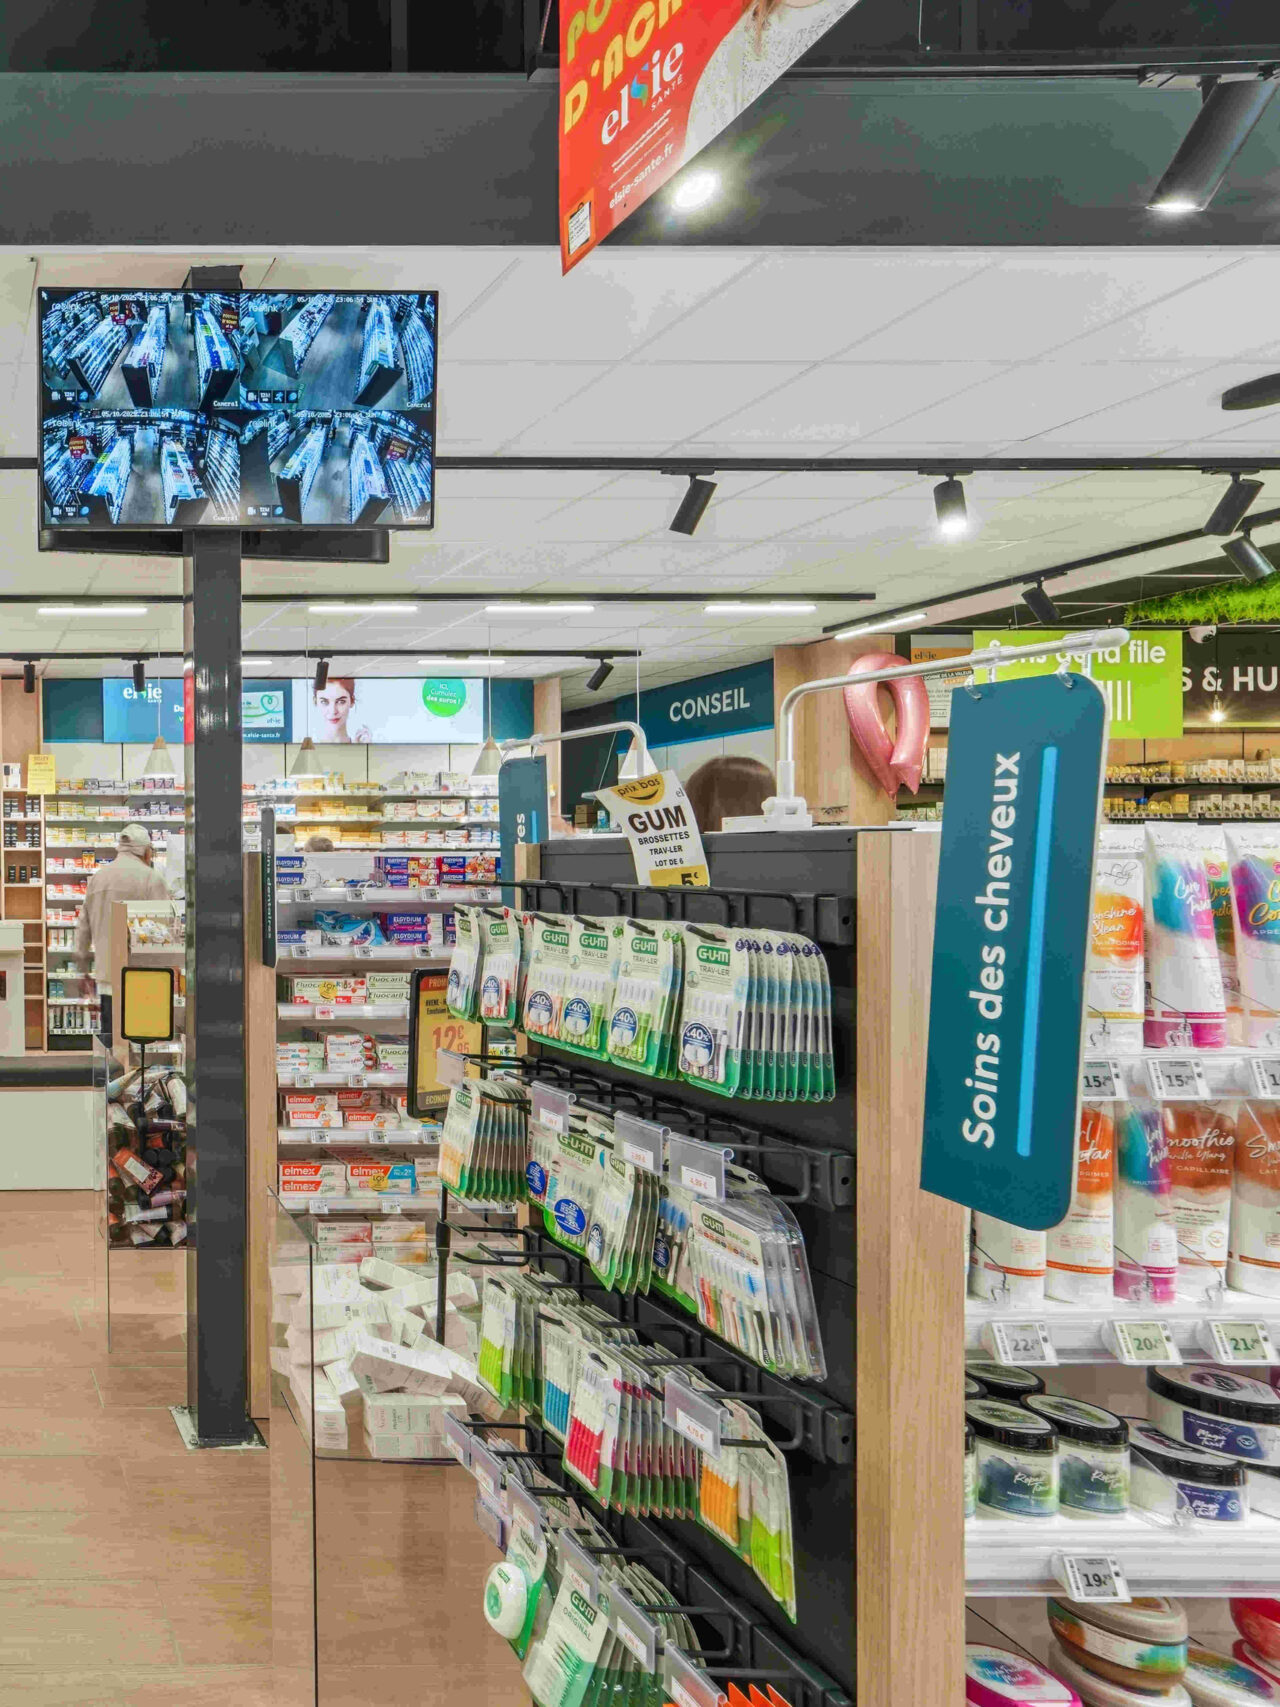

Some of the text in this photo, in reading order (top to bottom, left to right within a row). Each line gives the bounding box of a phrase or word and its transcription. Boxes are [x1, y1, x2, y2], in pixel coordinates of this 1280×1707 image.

[609, 143, 673, 209] elsie-sante.fr
[1128, 640, 1166, 664] file
[430, 689, 457, 698] Cumulez
[440, 696, 456, 704] euros
[669, 687, 750, 723] CONSEIL
[628, 804, 687, 834] GUM
[638, 831, 690, 846] BROSSETTES
[649, 845, 683, 857] TRAV-LER
[654, 858, 668, 867] LOT
[669, 858, 679, 867] DE
[962, 751, 1021, 1149] Soins des cheveux
[368, 991, 404, 999] Fluocaril
[284, 1167, 315, 1176] elmex
[352, 1167, 384, 1176] elmex
[284, 1182, 316, 1191] elmex
[562, 1608, 592, 1642] ORIGINAL
